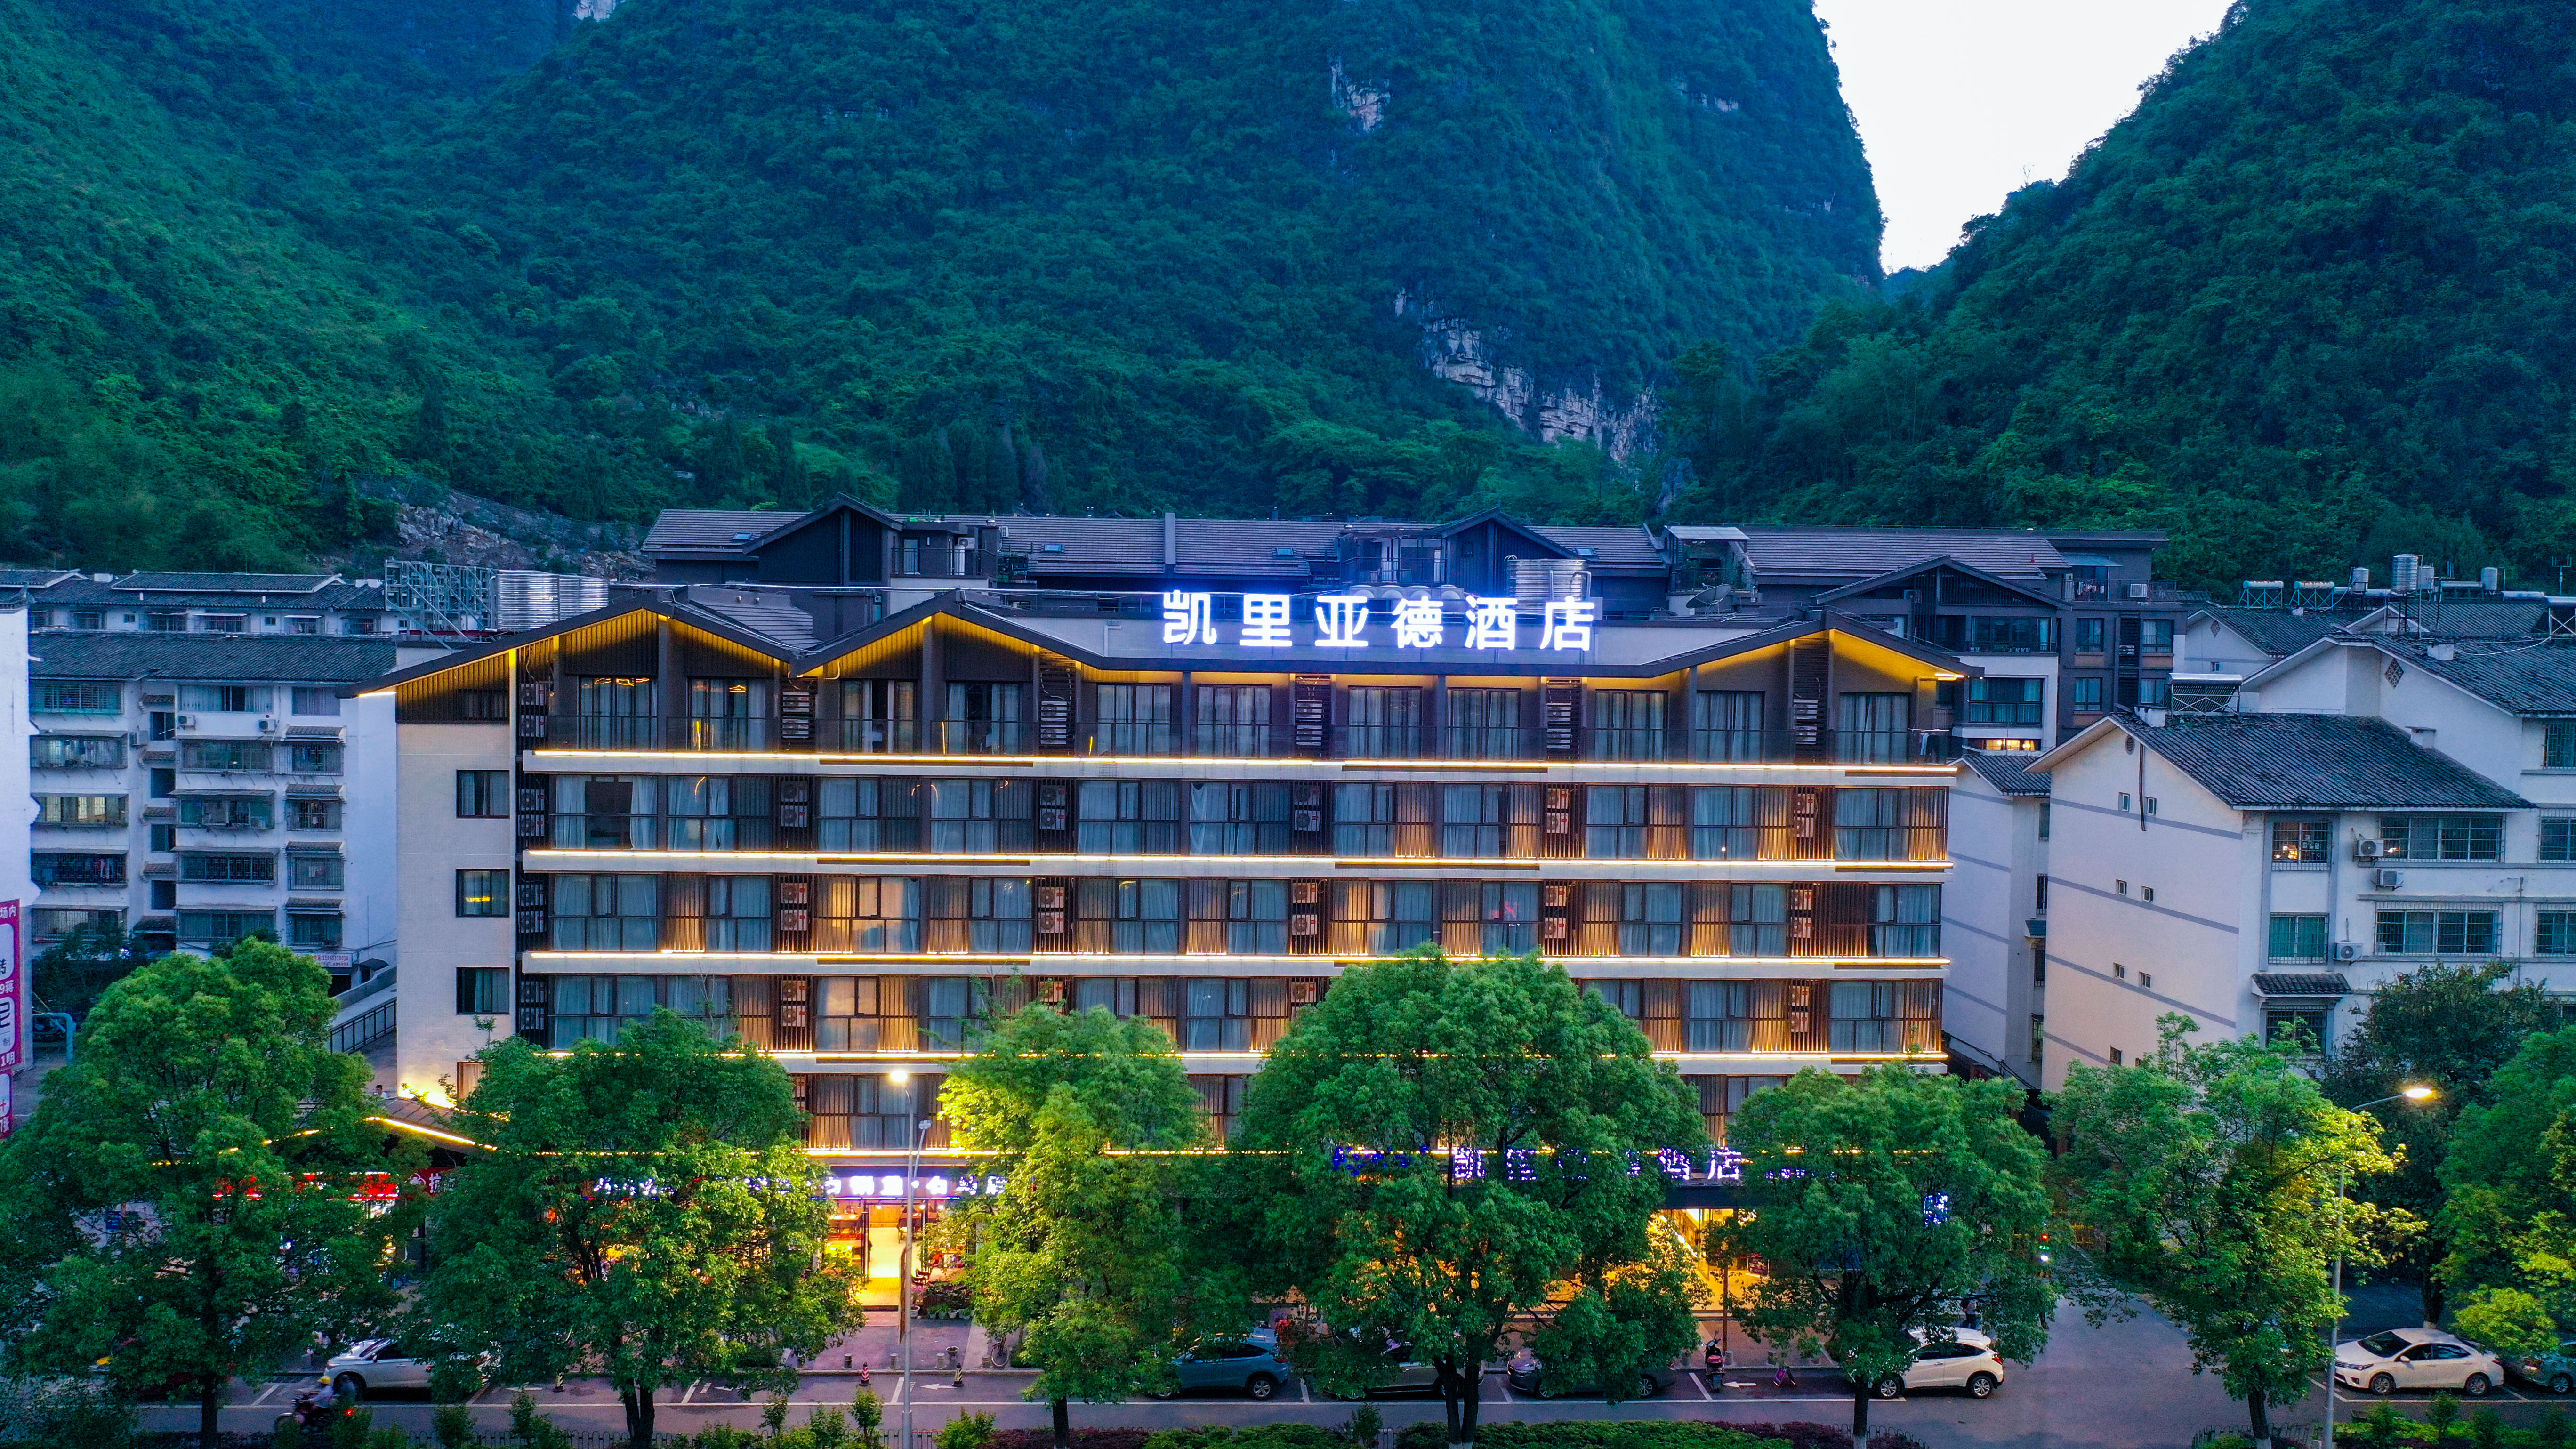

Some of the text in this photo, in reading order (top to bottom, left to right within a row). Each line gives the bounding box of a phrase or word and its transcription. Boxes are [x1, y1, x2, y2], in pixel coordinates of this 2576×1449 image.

[1162, 589, 1595, 651] 凯里亚德酒店
[1454, 1147, 1742, 1181] 凯里酒店
